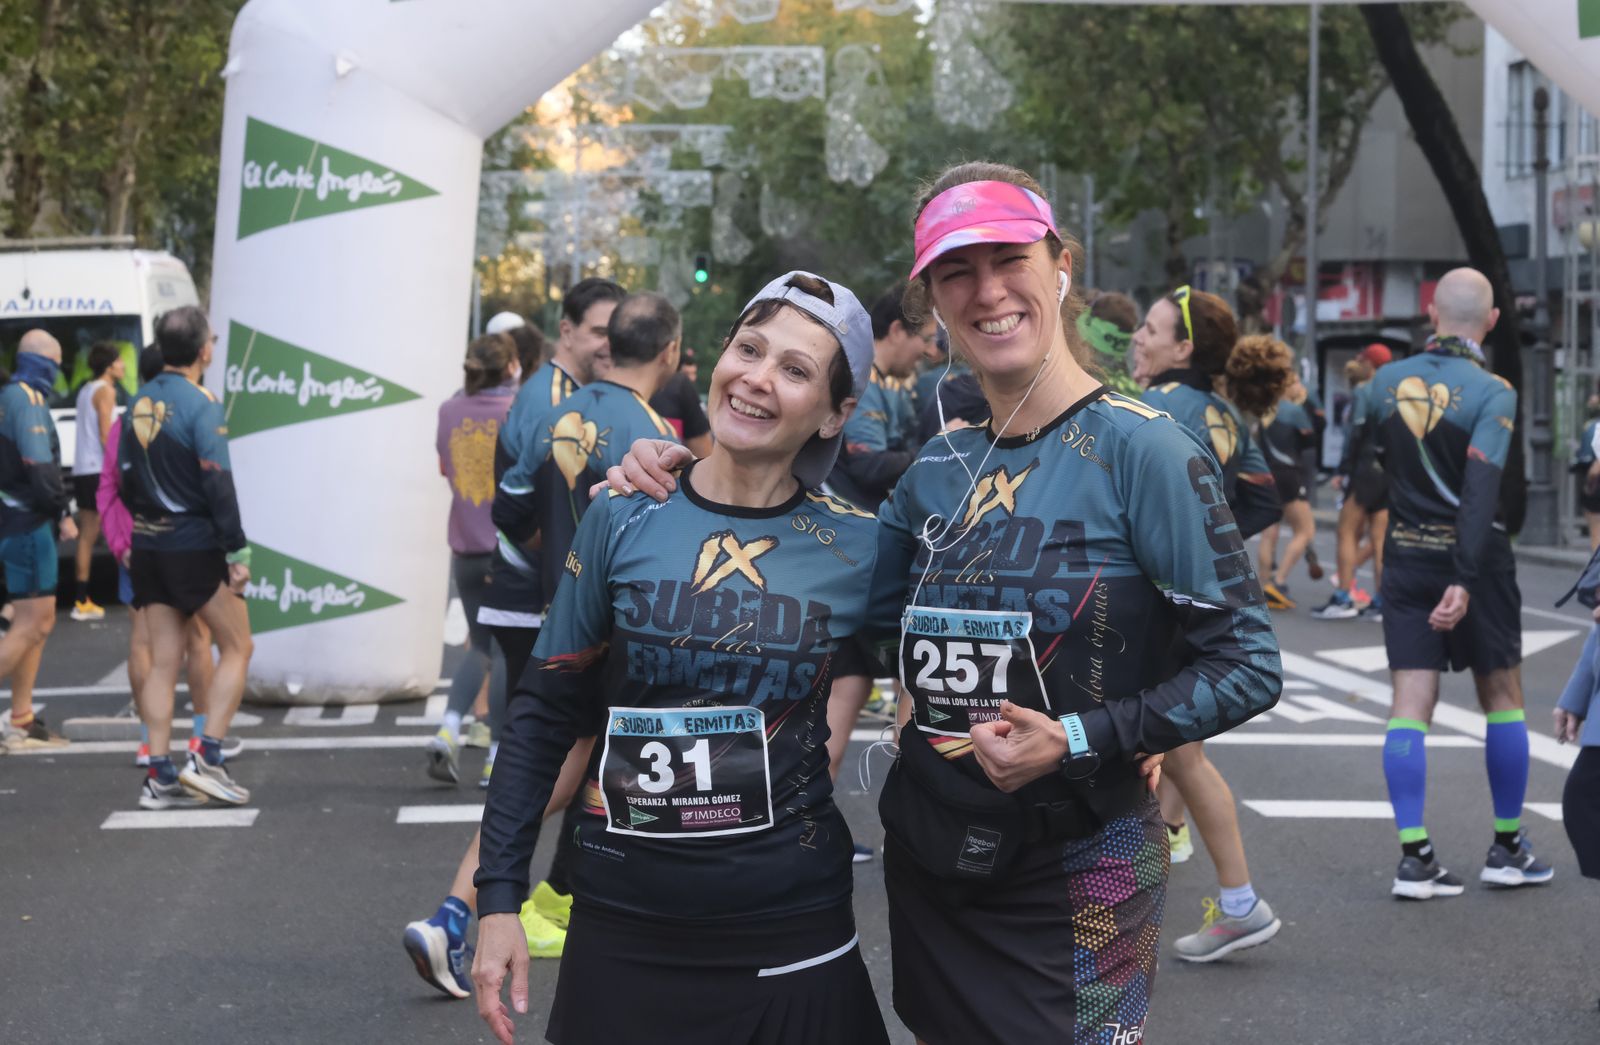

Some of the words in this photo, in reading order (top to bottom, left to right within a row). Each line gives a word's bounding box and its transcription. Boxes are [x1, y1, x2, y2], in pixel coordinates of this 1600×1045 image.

[243, 160, 262, 188] El
[264, 161, 315, 189] Corte
[316, 156, 403, 202] Inglés
[226, 364, 245, 393] El
[247, 366, 296, 395] Corte
[298, 361, 384, 408] Inglés
[1061, 422, 1096, 457] SIG
[791, 513, 836, 545] SIG
[691, 530, 778, 597] IX
[279, 568, 365, 614] Inglés
[622, 579, 835, 654] SUBIDA
[911, 615, 949, 634] SUBIDA
[963, 620, 1024, 637] ERMITAS
[627, 640, 816, 707] ERMITAS
[913, 639, 1012, 694] 257
[952, 698, 968, 706] LORA
[970, 699, 979, 707] DE
[980, 699, 990, 707] LA
[991, 699, 1009, 708] VE
[979, 712, 1002, 722] IMDE
[624, 716, 665, 735] SUBIDA
[684, 713, 756, 734] ERMITAS
[638, 738, 712, 793] 31
[626, 796, 668, 806] ESPERANZA
[671, 796, 710, 806] MIRANDA
[711, 794, 742, 804] GÓMEZ
[694, 807, 741, 820] IMDECO
[967, 835, 997, 848] Reebok
